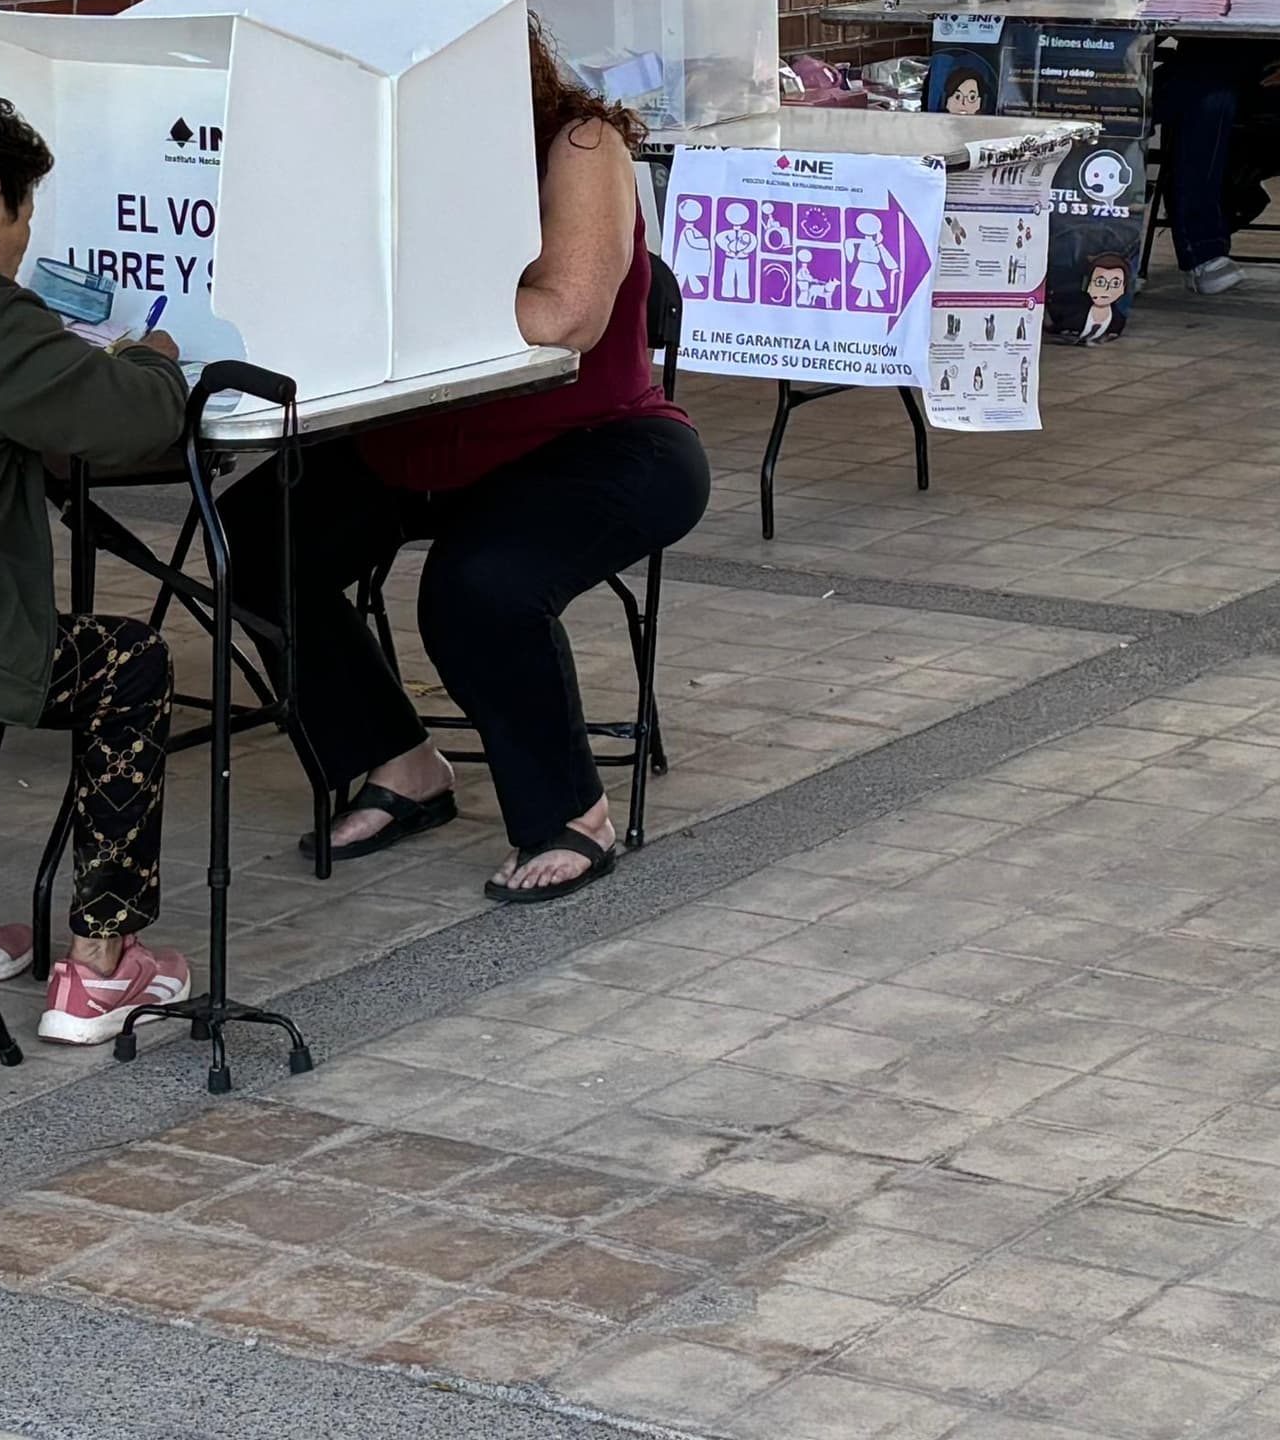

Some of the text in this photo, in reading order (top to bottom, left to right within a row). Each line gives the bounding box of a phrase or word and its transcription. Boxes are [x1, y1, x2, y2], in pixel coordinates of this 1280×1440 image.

[1051, 37, 1081, 48] tienes
[1083, 38, 1115, 50] dudas
[794, 159, 834, 175] INE
[118, 194, 158, 233] EL
[175, 255, 197, 294] Y
[692, 330, 898, 358] EL INE GARANTIZA LA INCLUSIÓN
[782, 355, 798, 368] SU
[802, 357, 861, 373] DERECHO
[864, 362, 878, 374] AL
[881, 363, 912, 376] VOTO
